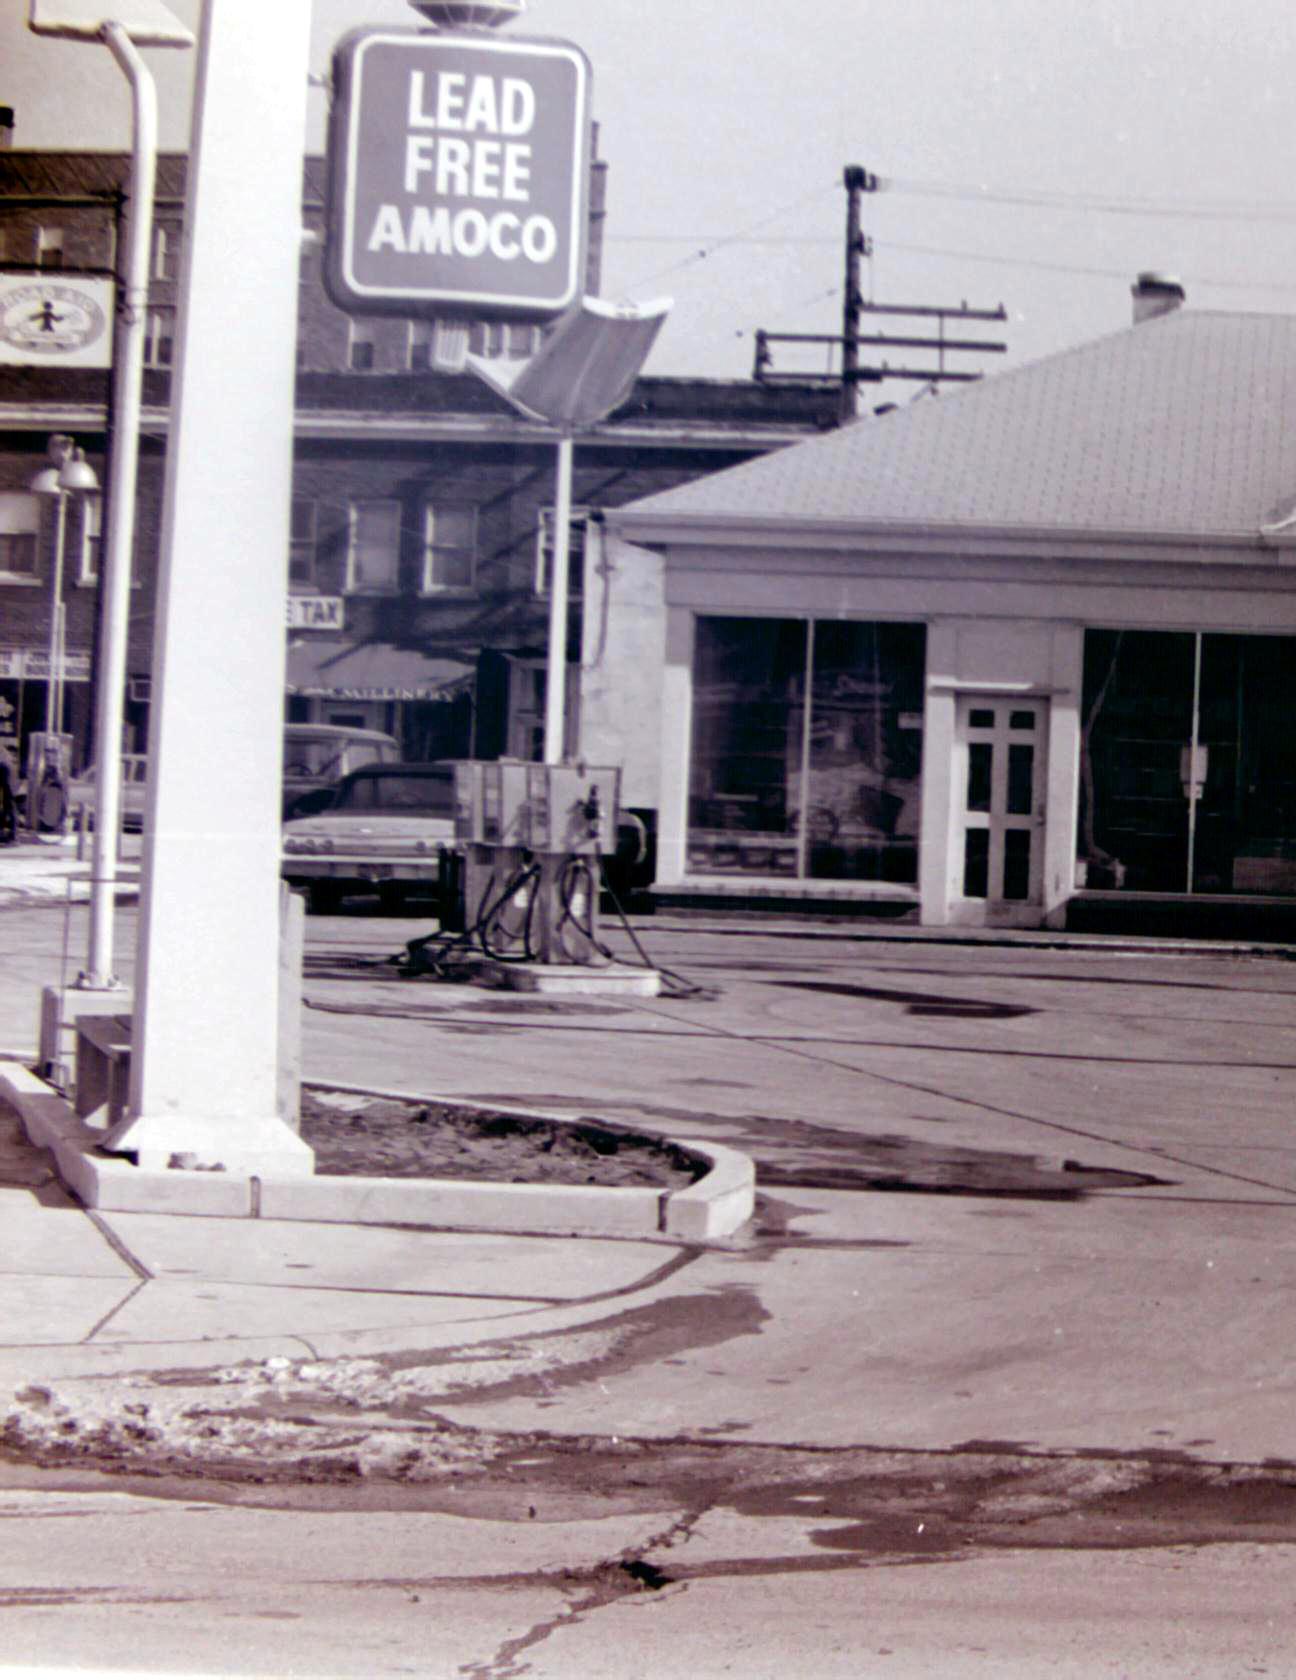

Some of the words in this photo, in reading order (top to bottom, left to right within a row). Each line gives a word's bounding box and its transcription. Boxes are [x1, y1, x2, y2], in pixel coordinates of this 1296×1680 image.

[407, 69, 536, 136] LEAD
[404, 134, 532, 202] FREE
[367, 203, 558, 264] AMOCO
[300, 600, 338, 625] TAX
